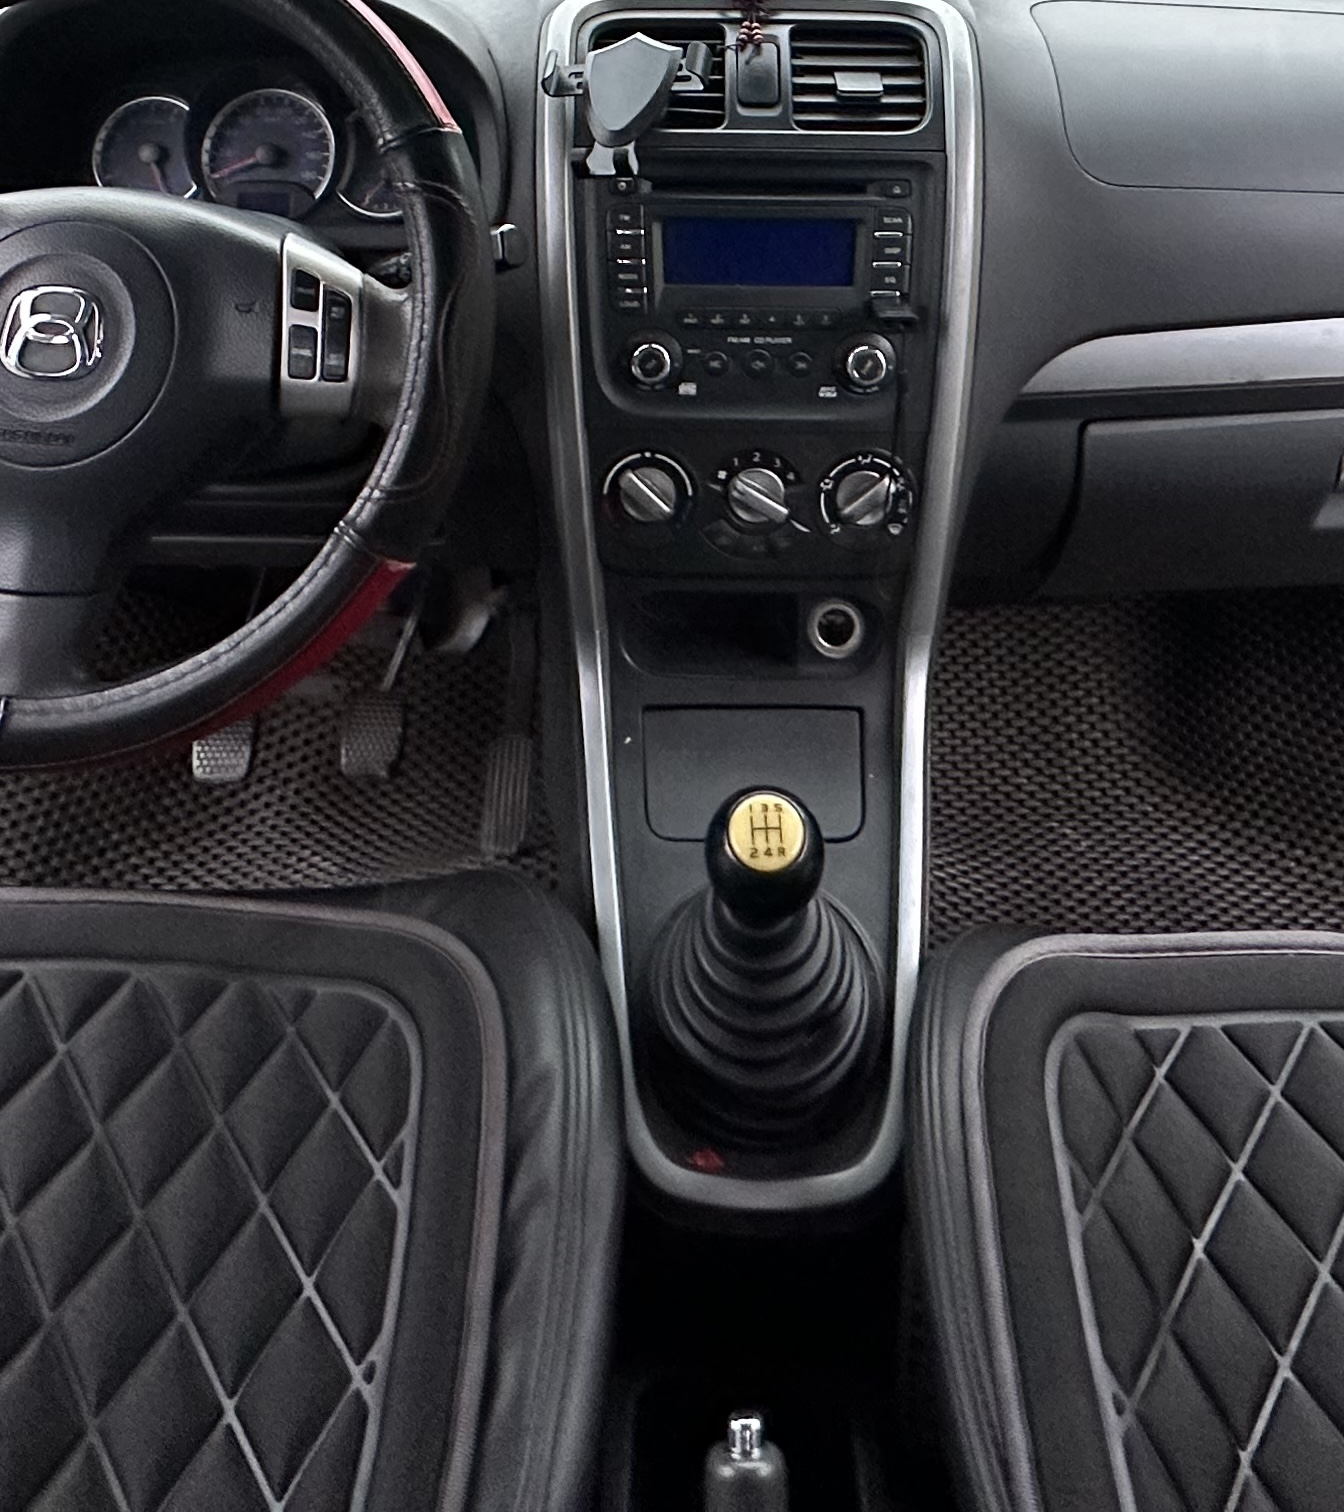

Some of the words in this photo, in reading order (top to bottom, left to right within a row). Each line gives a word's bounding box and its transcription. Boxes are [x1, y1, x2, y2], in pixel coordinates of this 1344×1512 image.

[733, 457, 739, 467] 1
[752, 452, 761, 463] 2
[773, 457, 782, 468] 3
[760, 803, 769, 813] 3
[773, 803, 784, 813] 5
[749, 847, 760, 859] 2
[763, 847, 774, 857] 4
[777, 846, 786, 858] R
